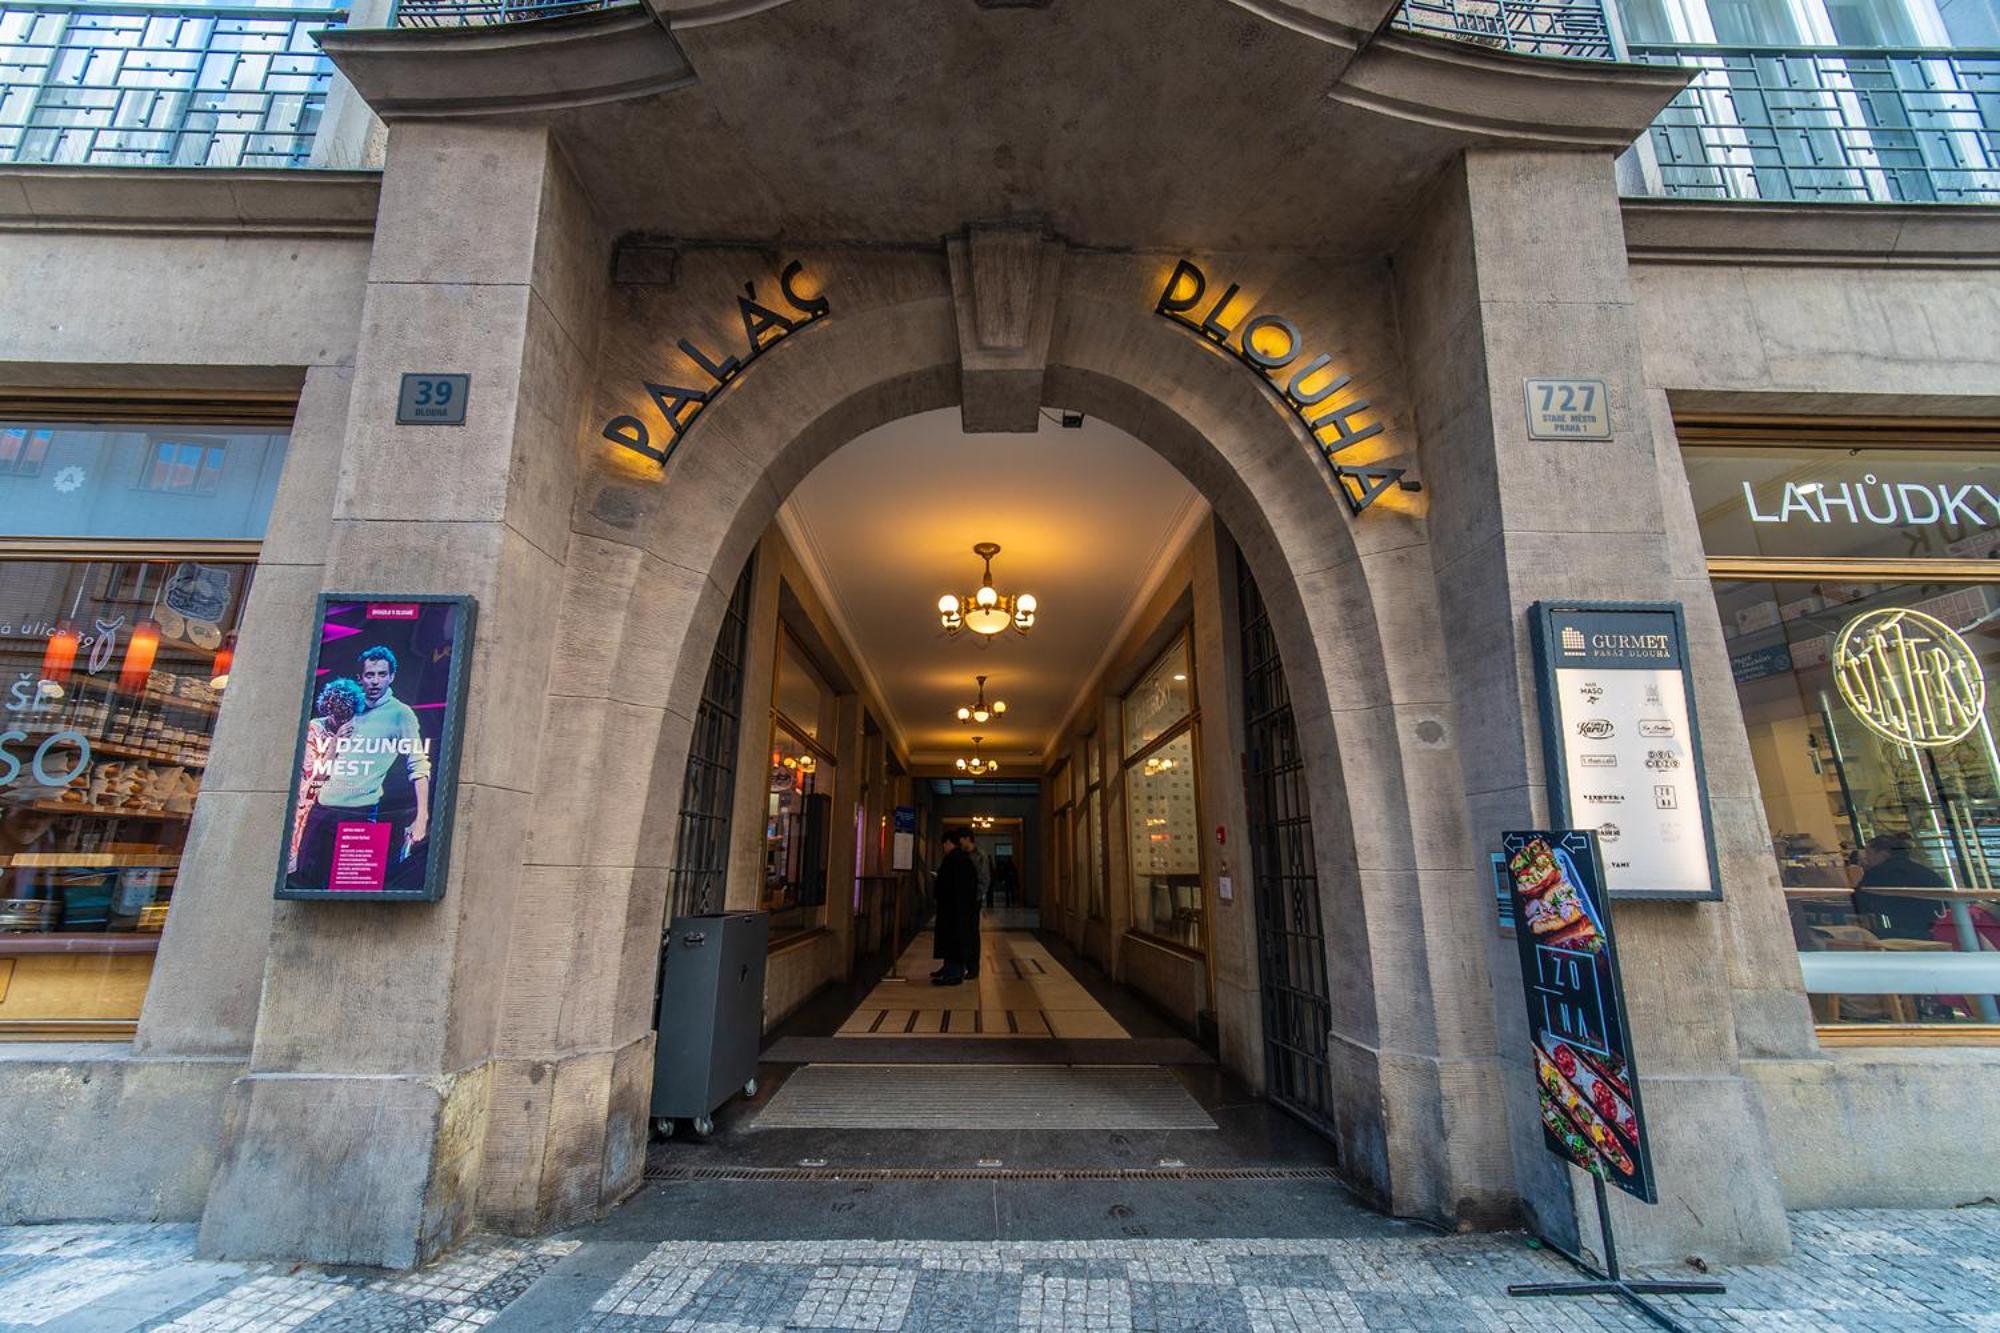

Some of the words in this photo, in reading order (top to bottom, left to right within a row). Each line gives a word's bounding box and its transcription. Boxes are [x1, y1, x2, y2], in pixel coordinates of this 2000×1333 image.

[415, 381, 453, 405] 39
[602, 259, 830, 467] PALÁC
[1155, 259, 1422, 517] DLOUHÁ
[1537, 385, 1595, 411] 727
[21, 621, 66, 639] ulice
[1592, 634, 1669, 649] GURMET
[316, 737, 332, 754] V
[335, 734, 431, 754] DŽUNGLI
[312, 754, 375, 776] MĚST
